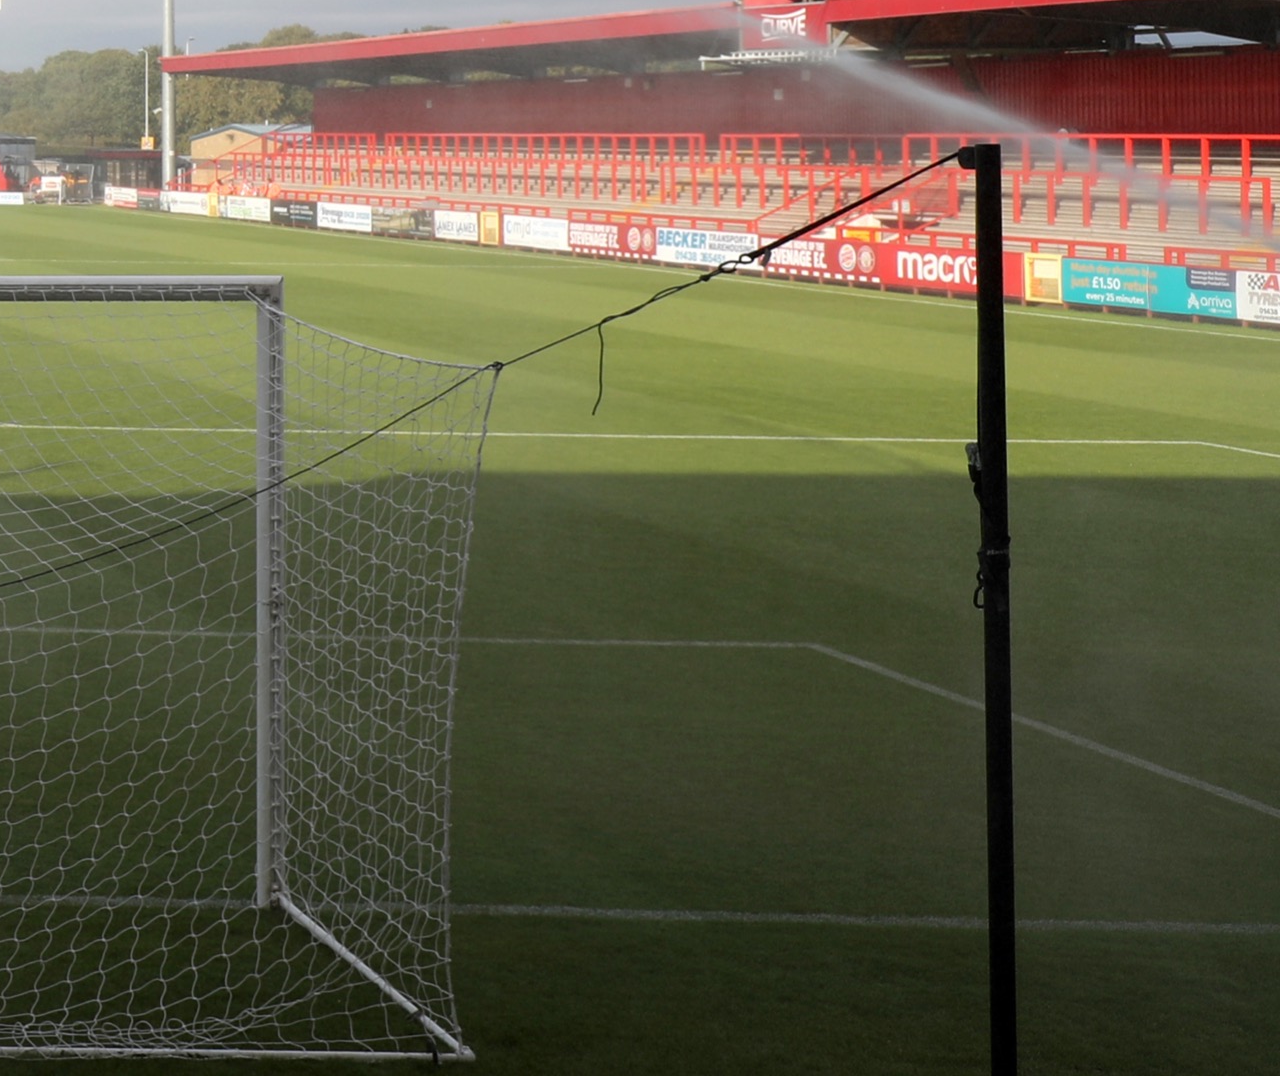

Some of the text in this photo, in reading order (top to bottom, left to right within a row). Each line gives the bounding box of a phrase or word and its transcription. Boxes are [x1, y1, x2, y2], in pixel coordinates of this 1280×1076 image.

[761, 13, 807, 37] CURVE
[570, 231, 608, 247] STEVENAGE
[657, 229, 707, 249] BECKER
[709, 233, 748, 244] TRANSPORT
[675, 250, 697, 261] 01438
[770, 249, 813, 267] EVENAGE
[896, 250, 978, 285] macro
[1092, 276, 1121, 290] £1.50
[1085, 292, 1145, 305] every 25 minutes
[1200, 295, 1232, 309] arriva
[1248, 291, 1280, 307] TYRE
